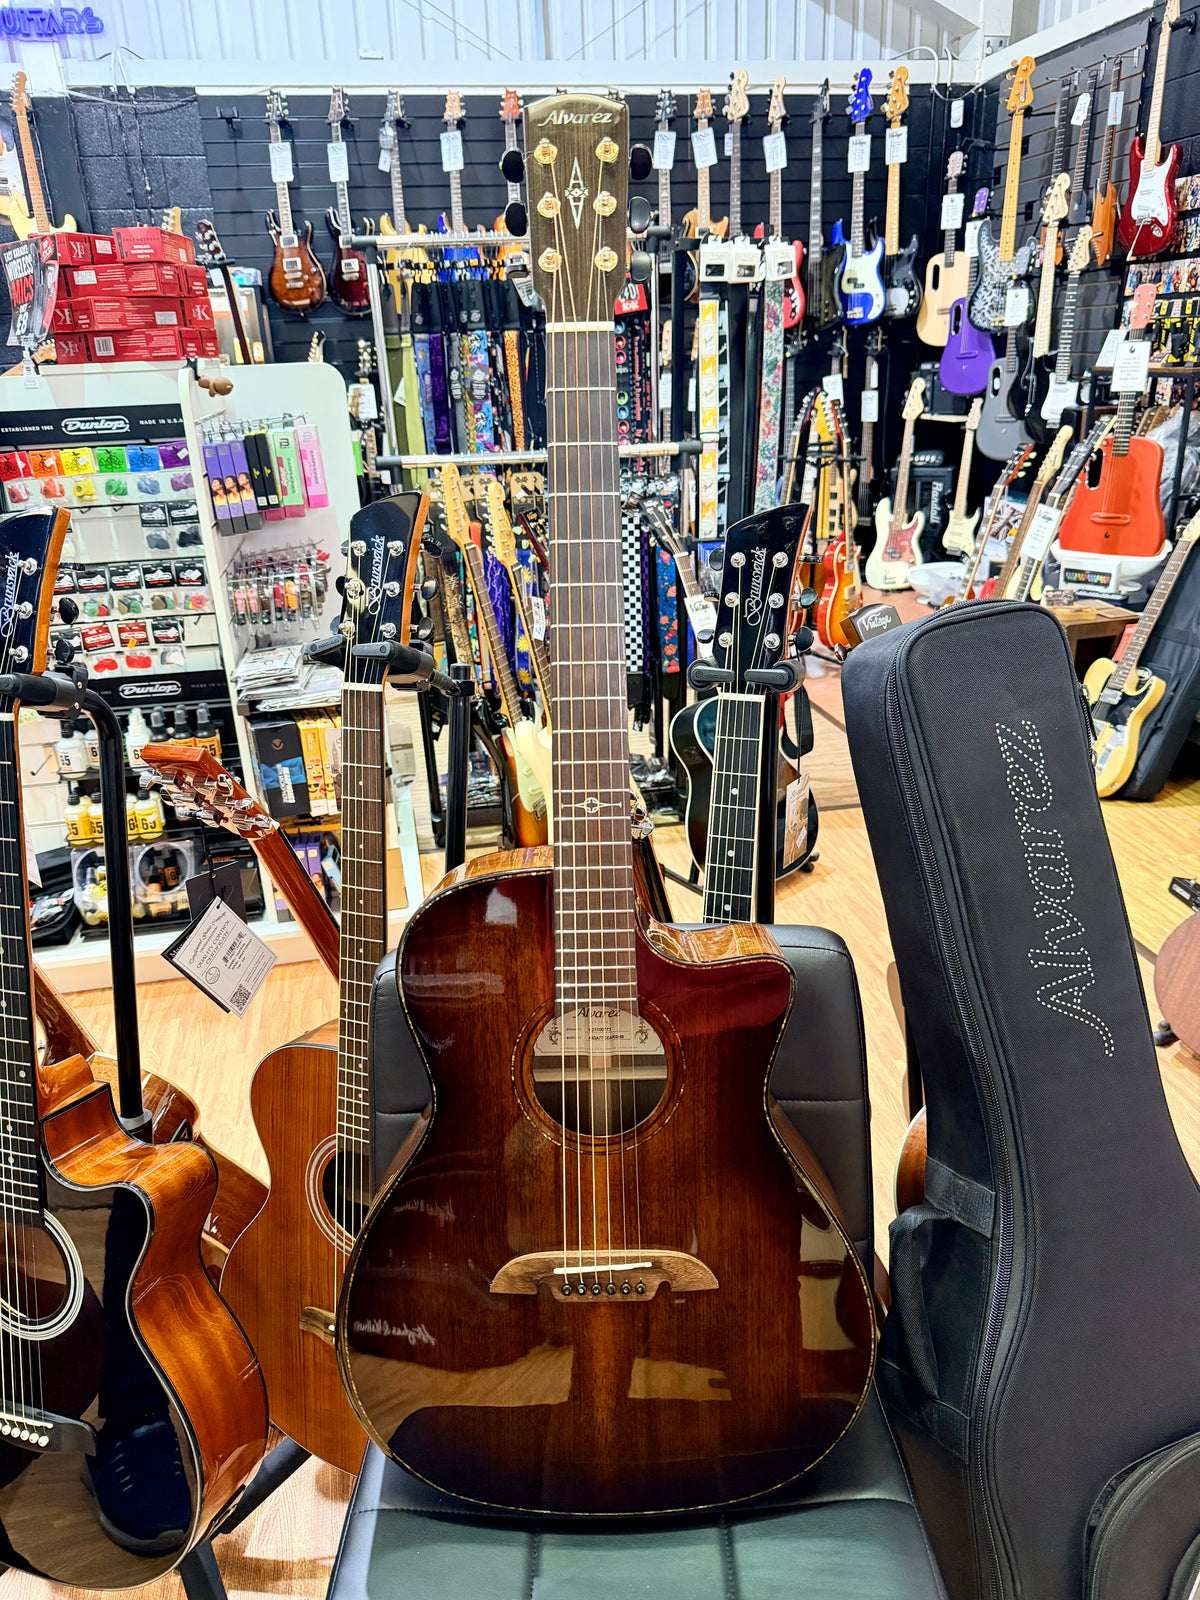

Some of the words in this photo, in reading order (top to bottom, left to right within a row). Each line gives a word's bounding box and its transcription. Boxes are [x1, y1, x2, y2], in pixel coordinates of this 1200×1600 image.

[537, 109, 613, 126] Alvarez
[5, 253, 34, 281] WIRELESS
[12, 274, 34, 307] MICS
[16, 311, 29, 336] £8
[1, 425, 40, 433] ESTABLISHED
[66, 419, 127, 431] Dunlop
[930, 481, 943, 523] Randall
[366, 535, 385, 615] Brunswick
[744, 546, 767, 626] Brunswick
[0, 551, 19, 637] Brunswick
[862, 612, 892, 631] Vintage
[124, 682, 180, 695] Dunlop
[997, 720, 1115, 1057] Alvarez
[197, 945, 213, 969] QUALITY
[212, 919, 231, 945] CONTROL
[572, 1007, 621, 1019] Alvarez
